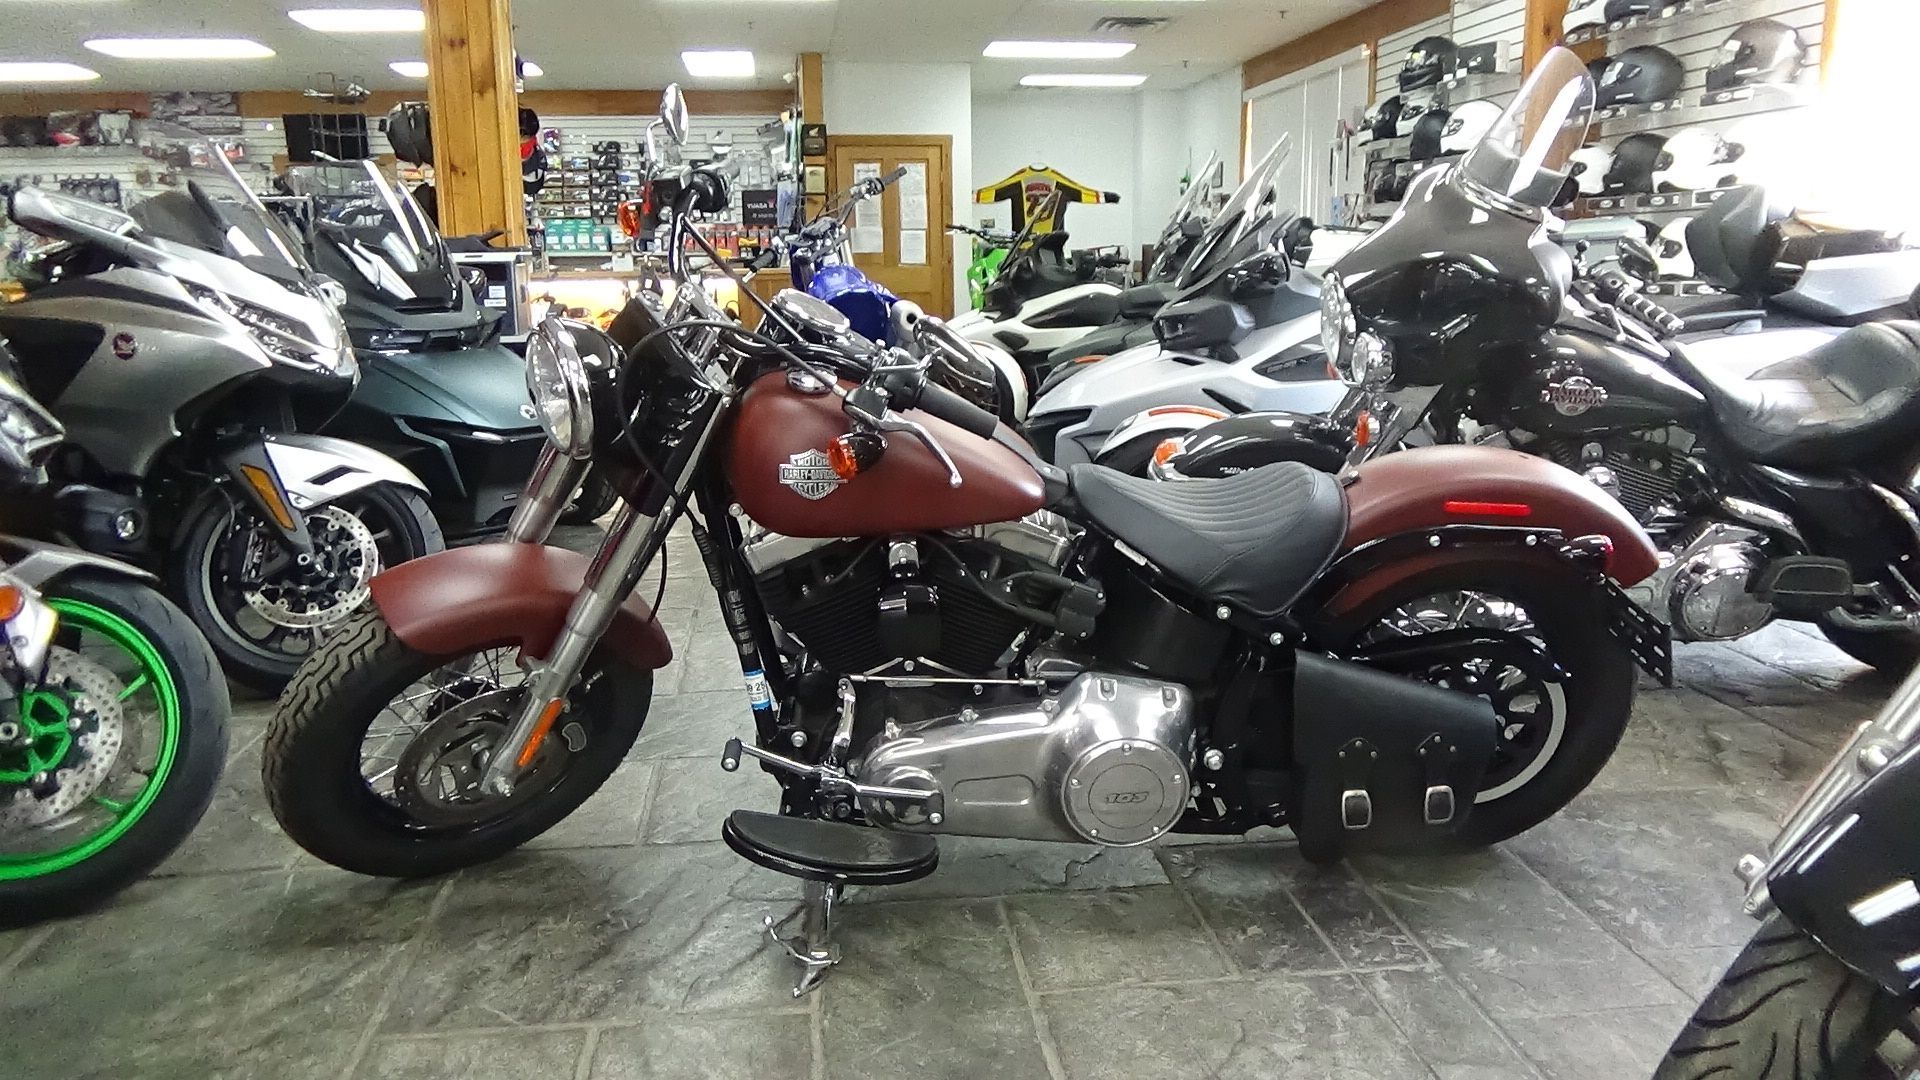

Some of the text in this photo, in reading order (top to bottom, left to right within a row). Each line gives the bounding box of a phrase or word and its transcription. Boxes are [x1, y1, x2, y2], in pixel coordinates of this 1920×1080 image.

[797, 454, 830, 466] MOTOR
[784, 469, 841, 479] HARLEY-DAVIDSO
[794, 482, 831, 496] CYCLES
[1105, 791, 1149, 803] 103
